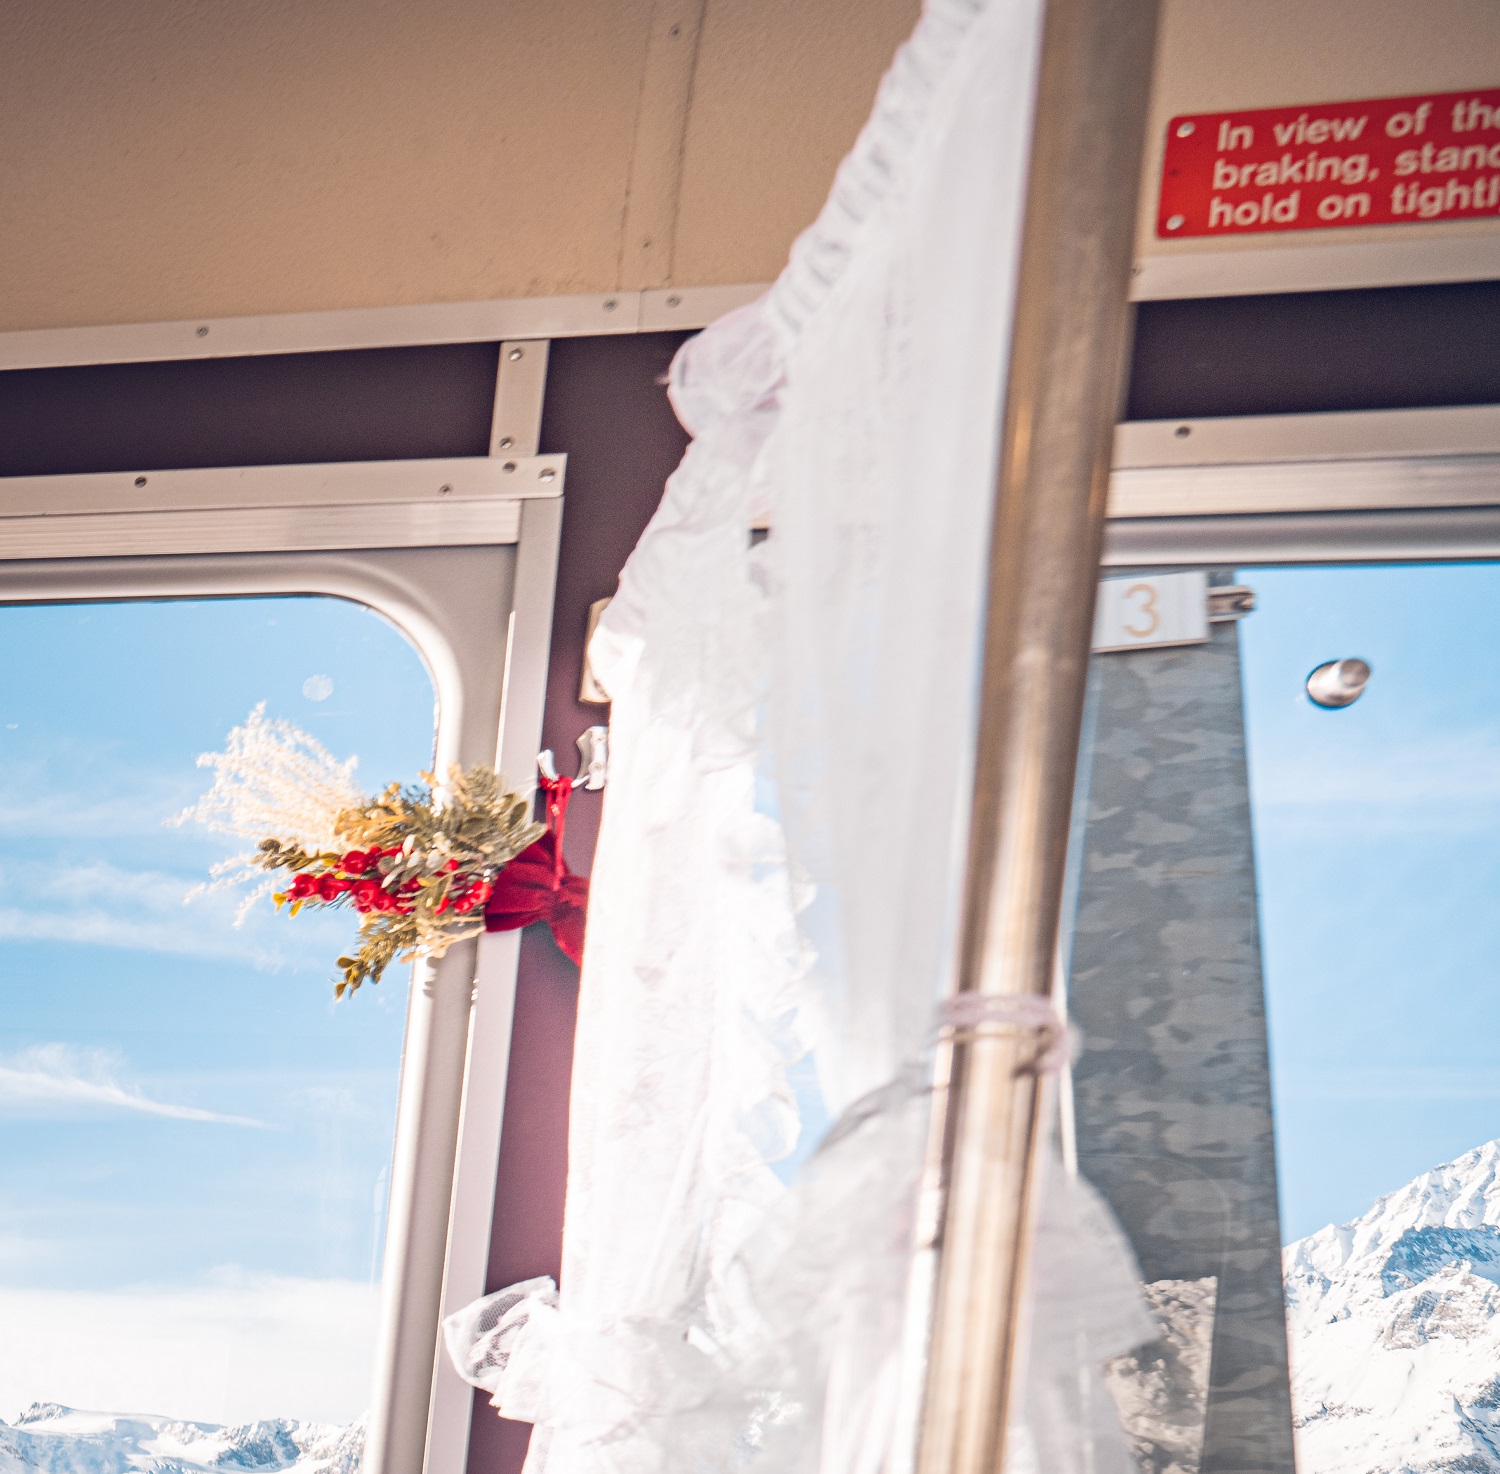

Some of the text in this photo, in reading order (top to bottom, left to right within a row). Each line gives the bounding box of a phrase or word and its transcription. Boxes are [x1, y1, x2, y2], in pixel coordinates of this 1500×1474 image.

[1216, 119, 1255, 152] In
[1272, 112, 1369, 147] view
[1385, 101, 1433, 137] of
[1211, 151, 1381, 190] braking,
[1208, 173, 1500, 228] hold on tightl
[1123, 583, 1161, 638] 3
